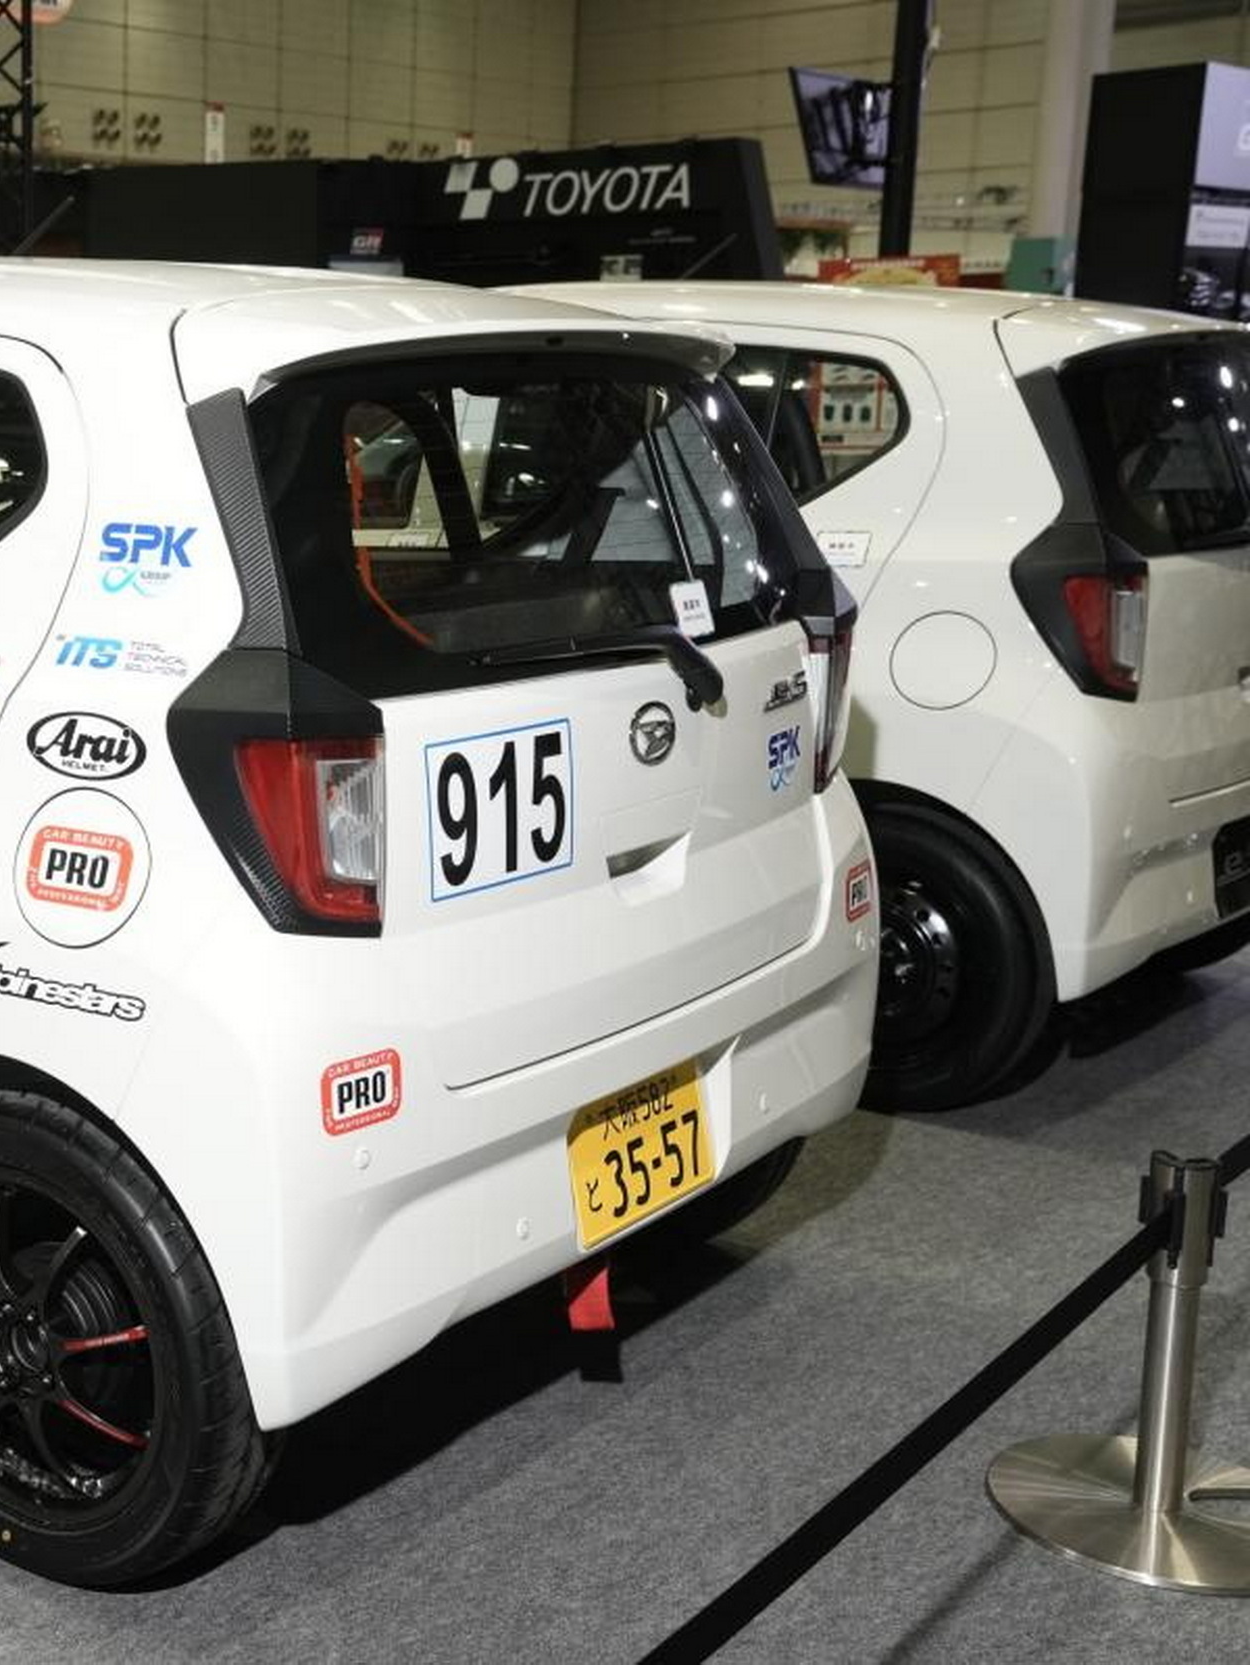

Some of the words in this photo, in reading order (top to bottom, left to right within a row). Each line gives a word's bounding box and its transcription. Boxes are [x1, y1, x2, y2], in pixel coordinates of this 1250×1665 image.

[523, 162, 690, 217] TOYOTA
[99, 523, 198, 568] SPK
[33, 718, 130, 764] Arai
[768, 725, 801, 769] SPK
[437, 731, 566, 886] 915
[46, 848, 109, 889] PRO
[337, 1070, 386, 1114] PRO
[585, 1177, 603, 1212] と
[603, 1109, 699, 1218] 35-57
